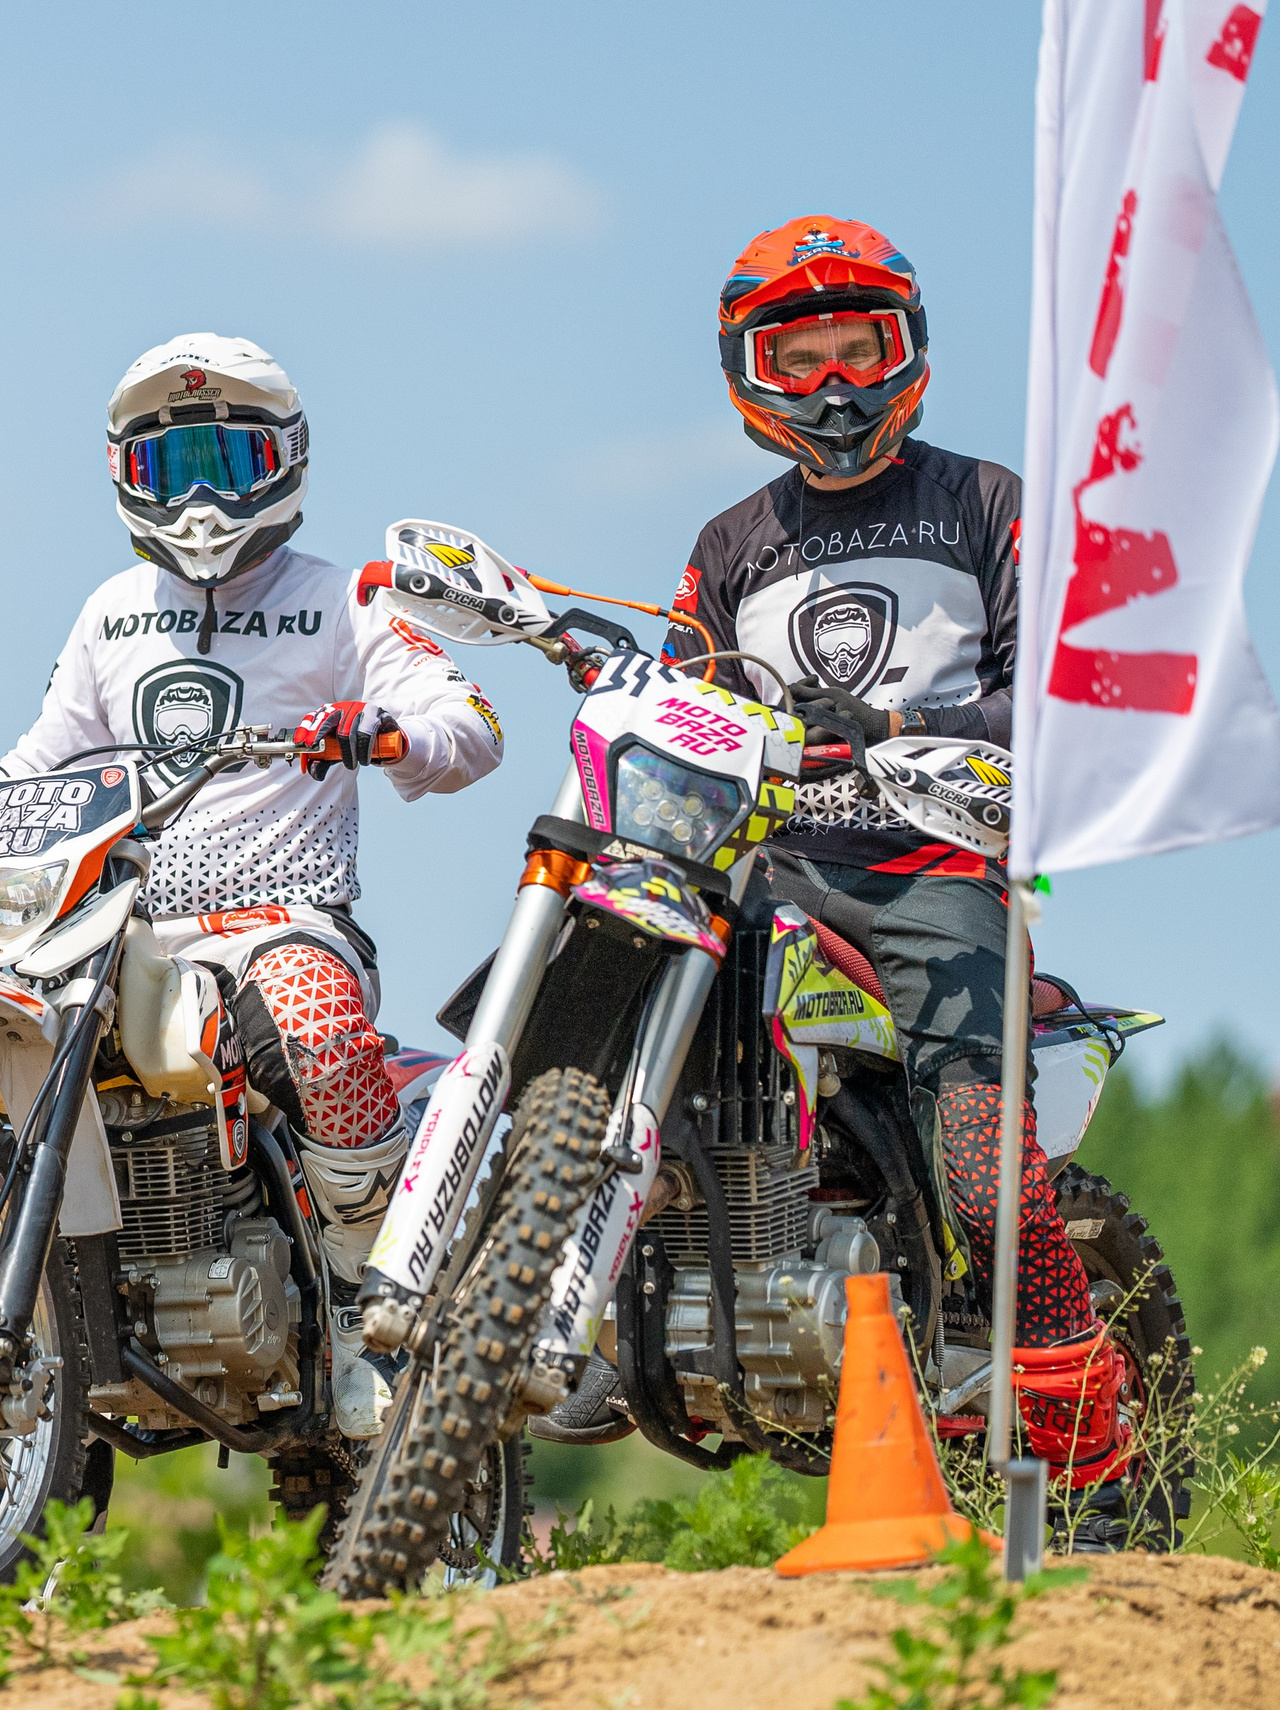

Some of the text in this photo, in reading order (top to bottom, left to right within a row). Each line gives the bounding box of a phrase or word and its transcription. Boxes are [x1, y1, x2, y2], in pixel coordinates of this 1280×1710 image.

[444, 589, 485, 611] CYCRA
[654, 712, 744, 752] BAZA
[656, 697, 748, 738] MOTO
[667, 733, 719, 756] RU
[929, 784, 970, 808] CYCRA
[407, 1050, 504, 1286] MOTOBAZA.RU
